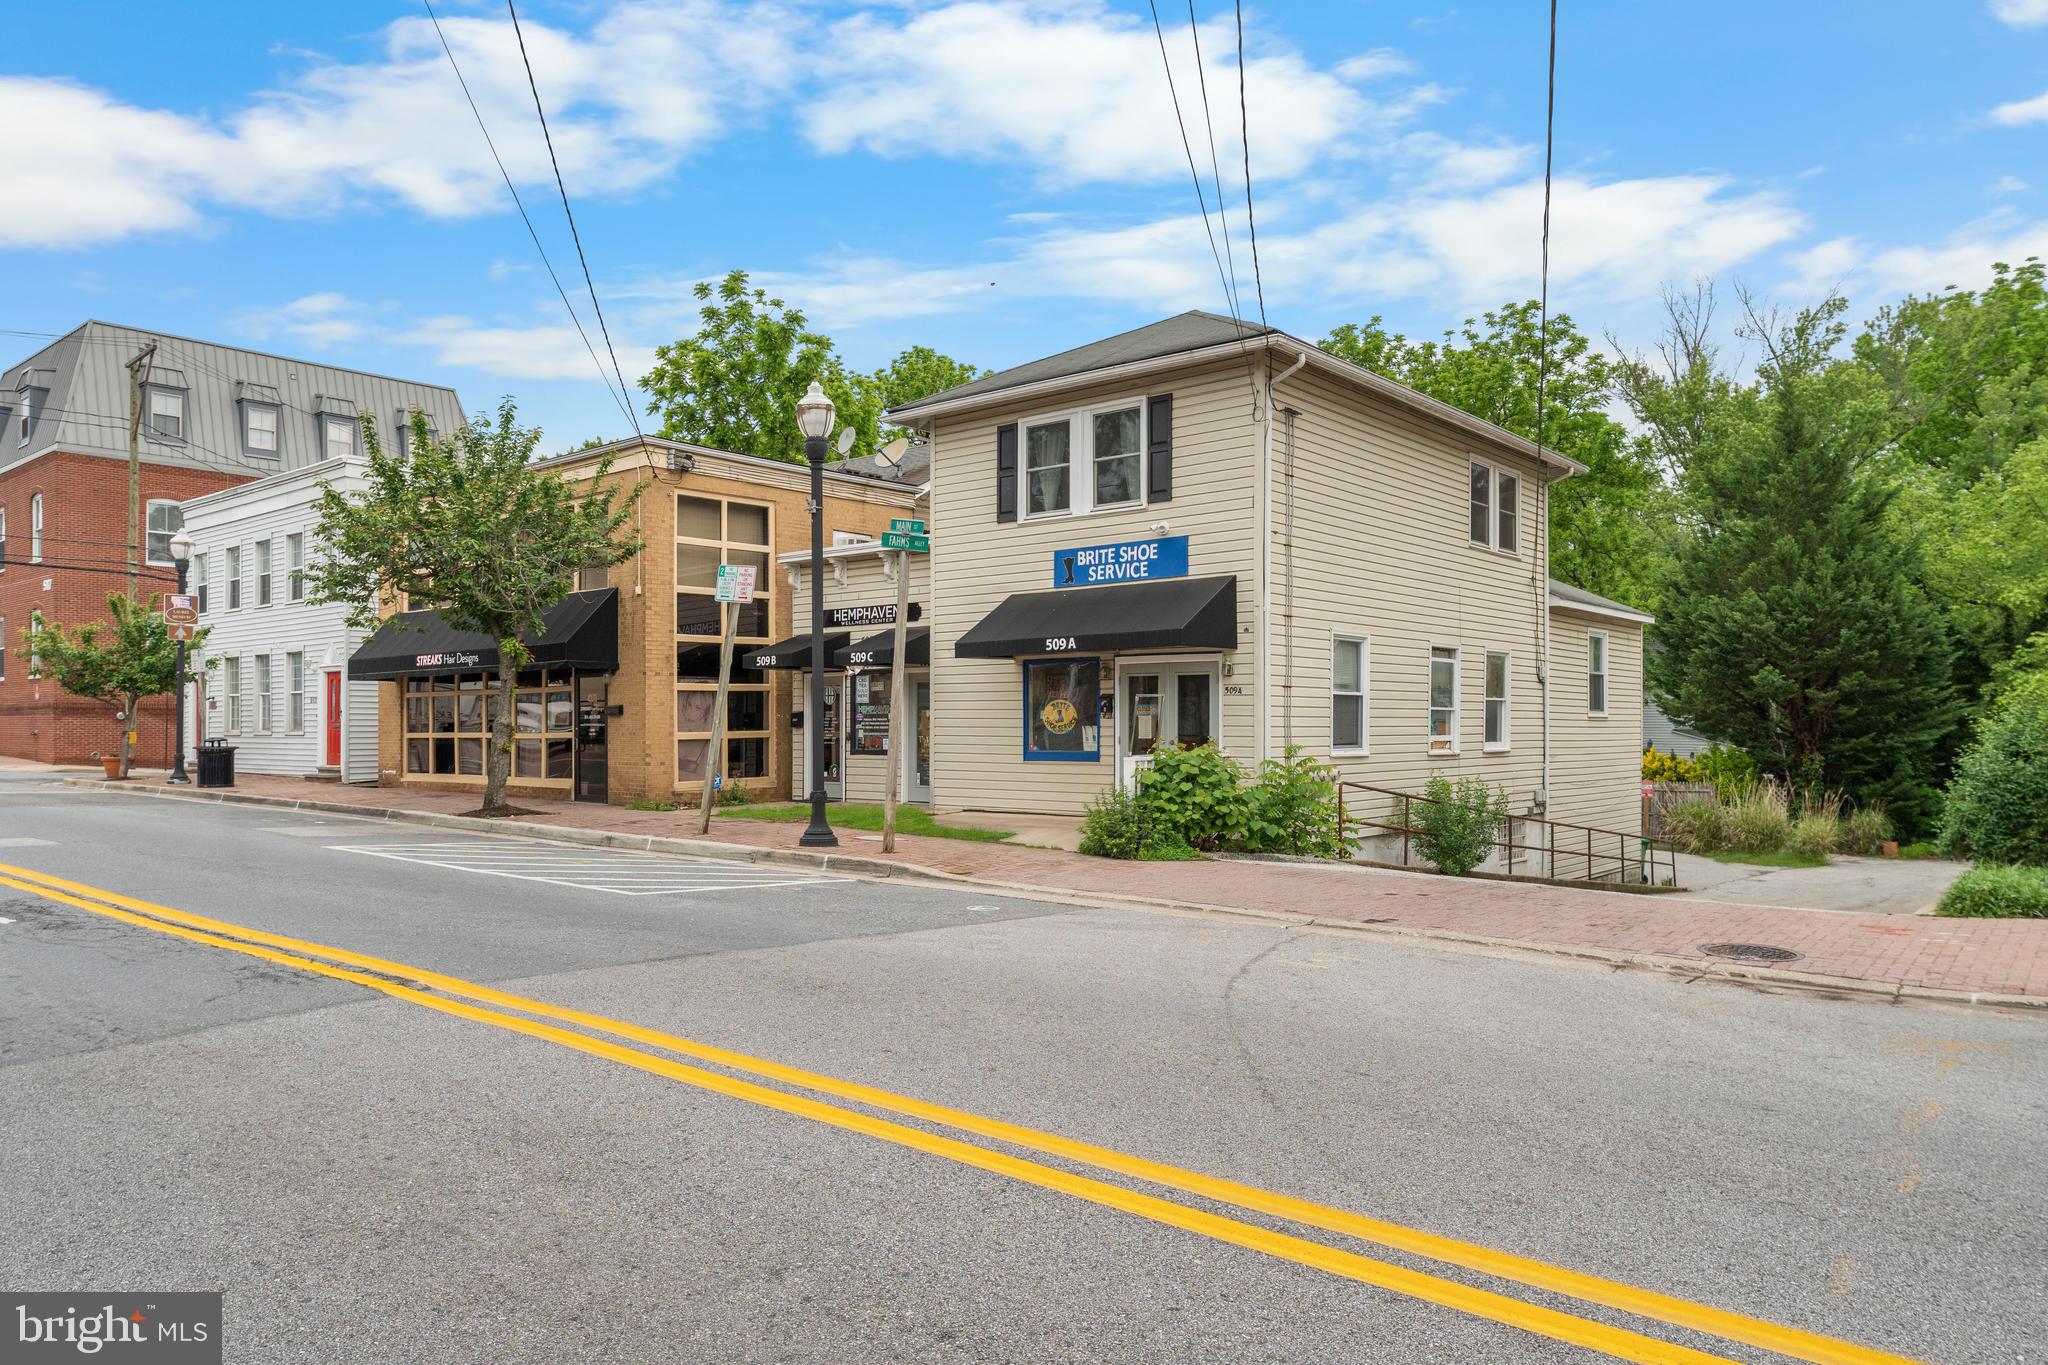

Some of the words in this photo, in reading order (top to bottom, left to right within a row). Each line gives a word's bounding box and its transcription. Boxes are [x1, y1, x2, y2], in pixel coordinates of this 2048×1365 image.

[896, 521, 912, 530] MAIN
[1077, 547, 1116, 566] BRITE
[1119, 543, 1159, 562] SHOE
[1088, 562, 1149, 581] SERVICE
[841, 618, 870, 626] WELLNESS
[1045, 637, 1067, 651] 509
[1067, 637, 1077, 649] A
[416, 653, 443, 666] STREAKS
[443, 653, 456, 664] Hair
[456, 652, 479, 667] Designs
[756, 656, 771, 666] 509
[771, 655, 777, 665] B
[850, 652, 867, 663] 509
[867, 651, 874, 662] C
[1224, 686, 1242, 694] 509A
